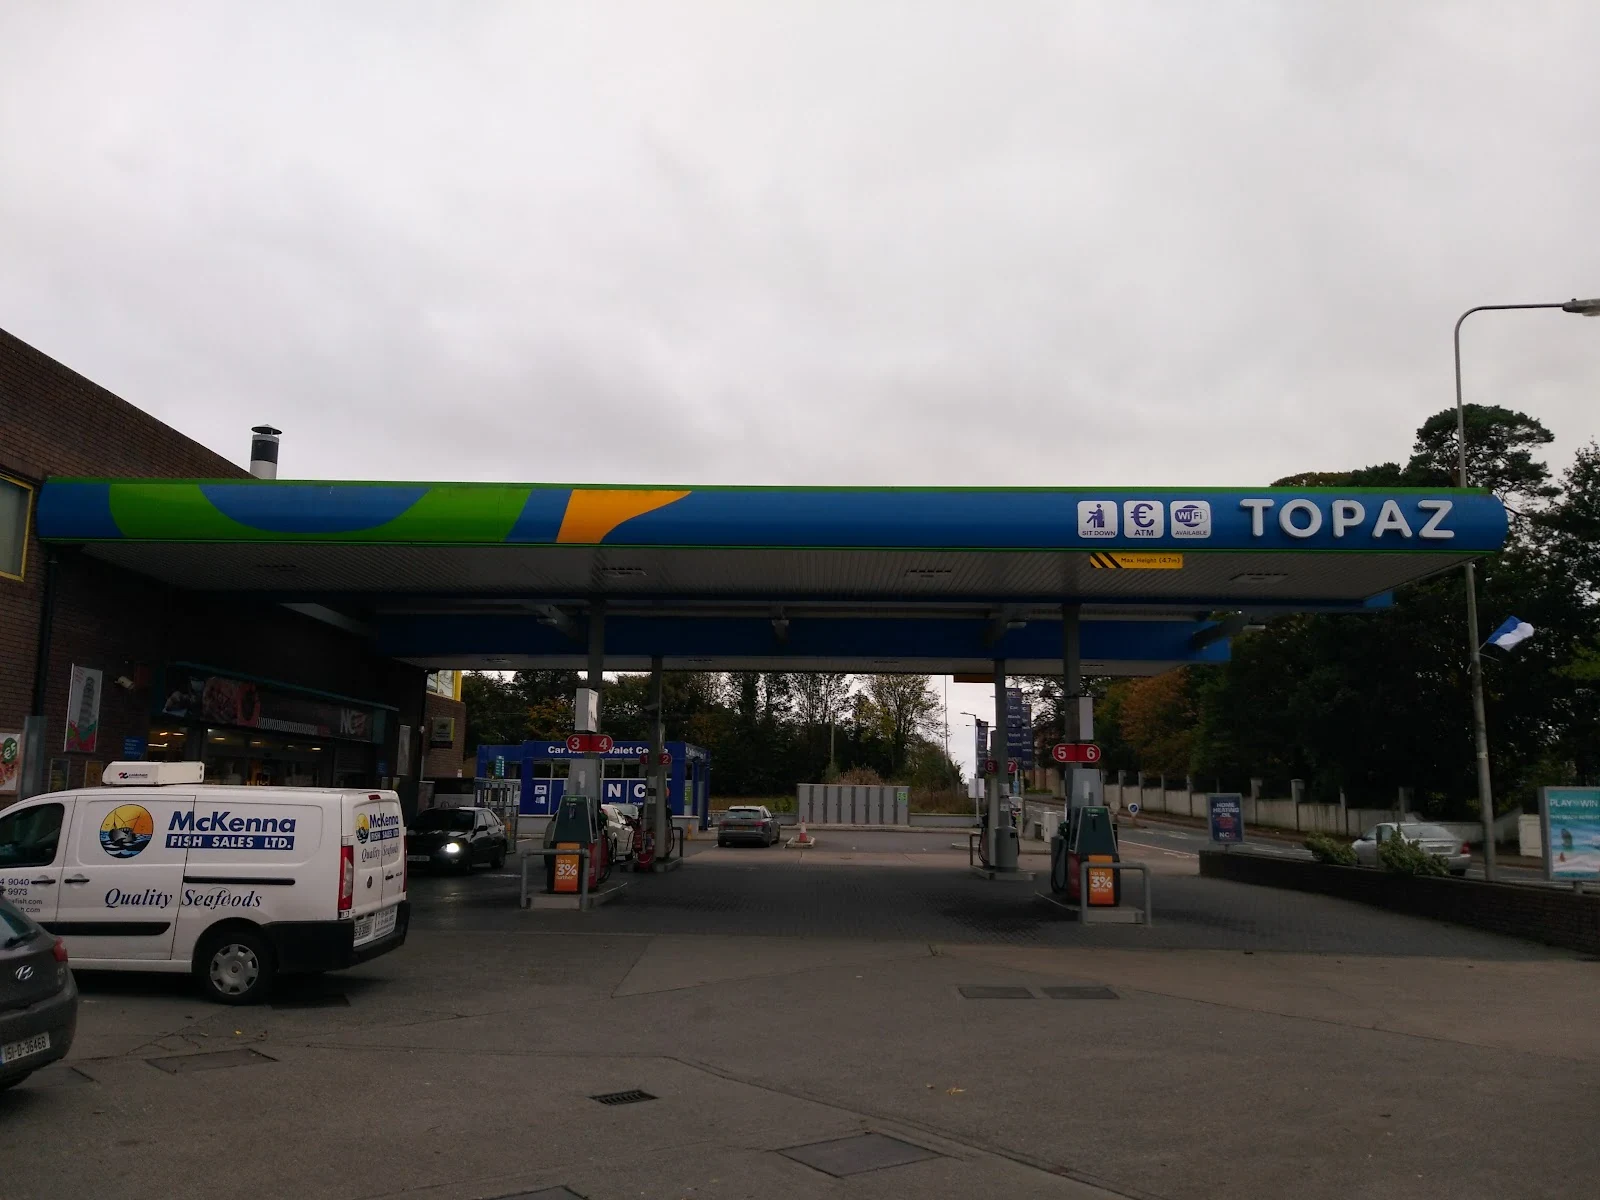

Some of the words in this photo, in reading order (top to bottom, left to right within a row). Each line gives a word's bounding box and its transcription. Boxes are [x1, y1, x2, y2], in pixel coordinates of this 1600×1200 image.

[1240, 498, 1455, 539] TOPAZ
[1134, 529, 1154, 537] ATM
[547, 745, 566, 755] Car
[608, 745, 634, 755] Valet
[570, 737, 580, 750] 3
[599, 737, 608, 750] 4
[644, 755, 649, 764] 1
[662, 755, 669, 764] 2
[1057, 747, 1067, 760] 5
[1086, 747, 1096, 760] 6
[987, 761, 994, 771] 8
[1007, 761, 1014, 771] 7
[1549, 799, 1571, 807] PLAY
[1580, 799, 1598, 807] WIN
[168, 811, 296, 832] McKenna
[369, 813, 399, 829] McKenna
[170, 835, 203, 847] FISH
[212, 836, 254, 848] SALES
[264, 836, 292, 848] LTD.
[361, 847, 380, 862] Quality
[556, 864, 577, 876] 3%
[8, 878, 30, 886] 9040
[1091, 876, 1113, 889] 3%
[8, 888, 28, 896] 9973
[105, 888, 173, 909] Quality
[181, 889, 262, 910] Seafoods
